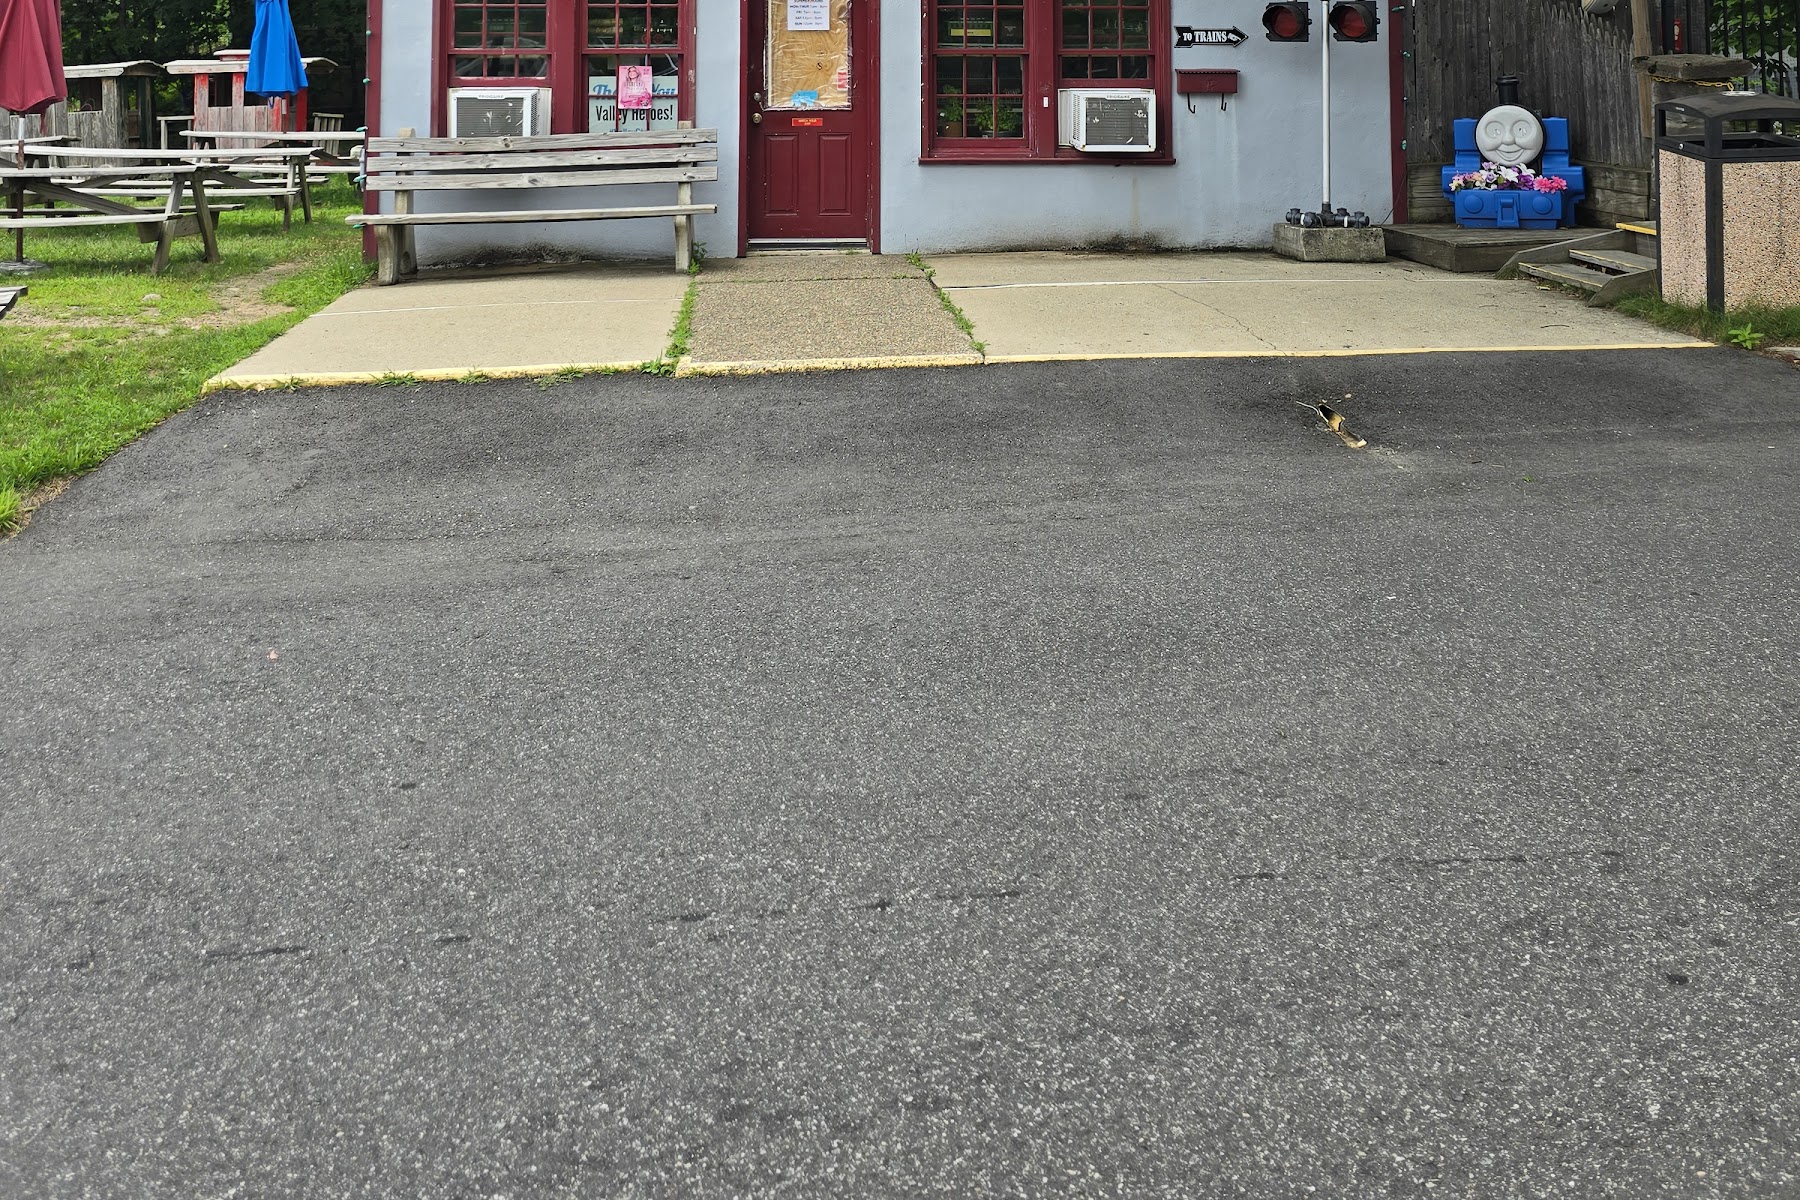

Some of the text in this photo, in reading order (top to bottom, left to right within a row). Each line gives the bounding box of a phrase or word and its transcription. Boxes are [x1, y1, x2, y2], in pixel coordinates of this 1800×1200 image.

[1183, 31, 1227, 42] TO TRAINS
[632, 104, 674, 121] Heoes!
